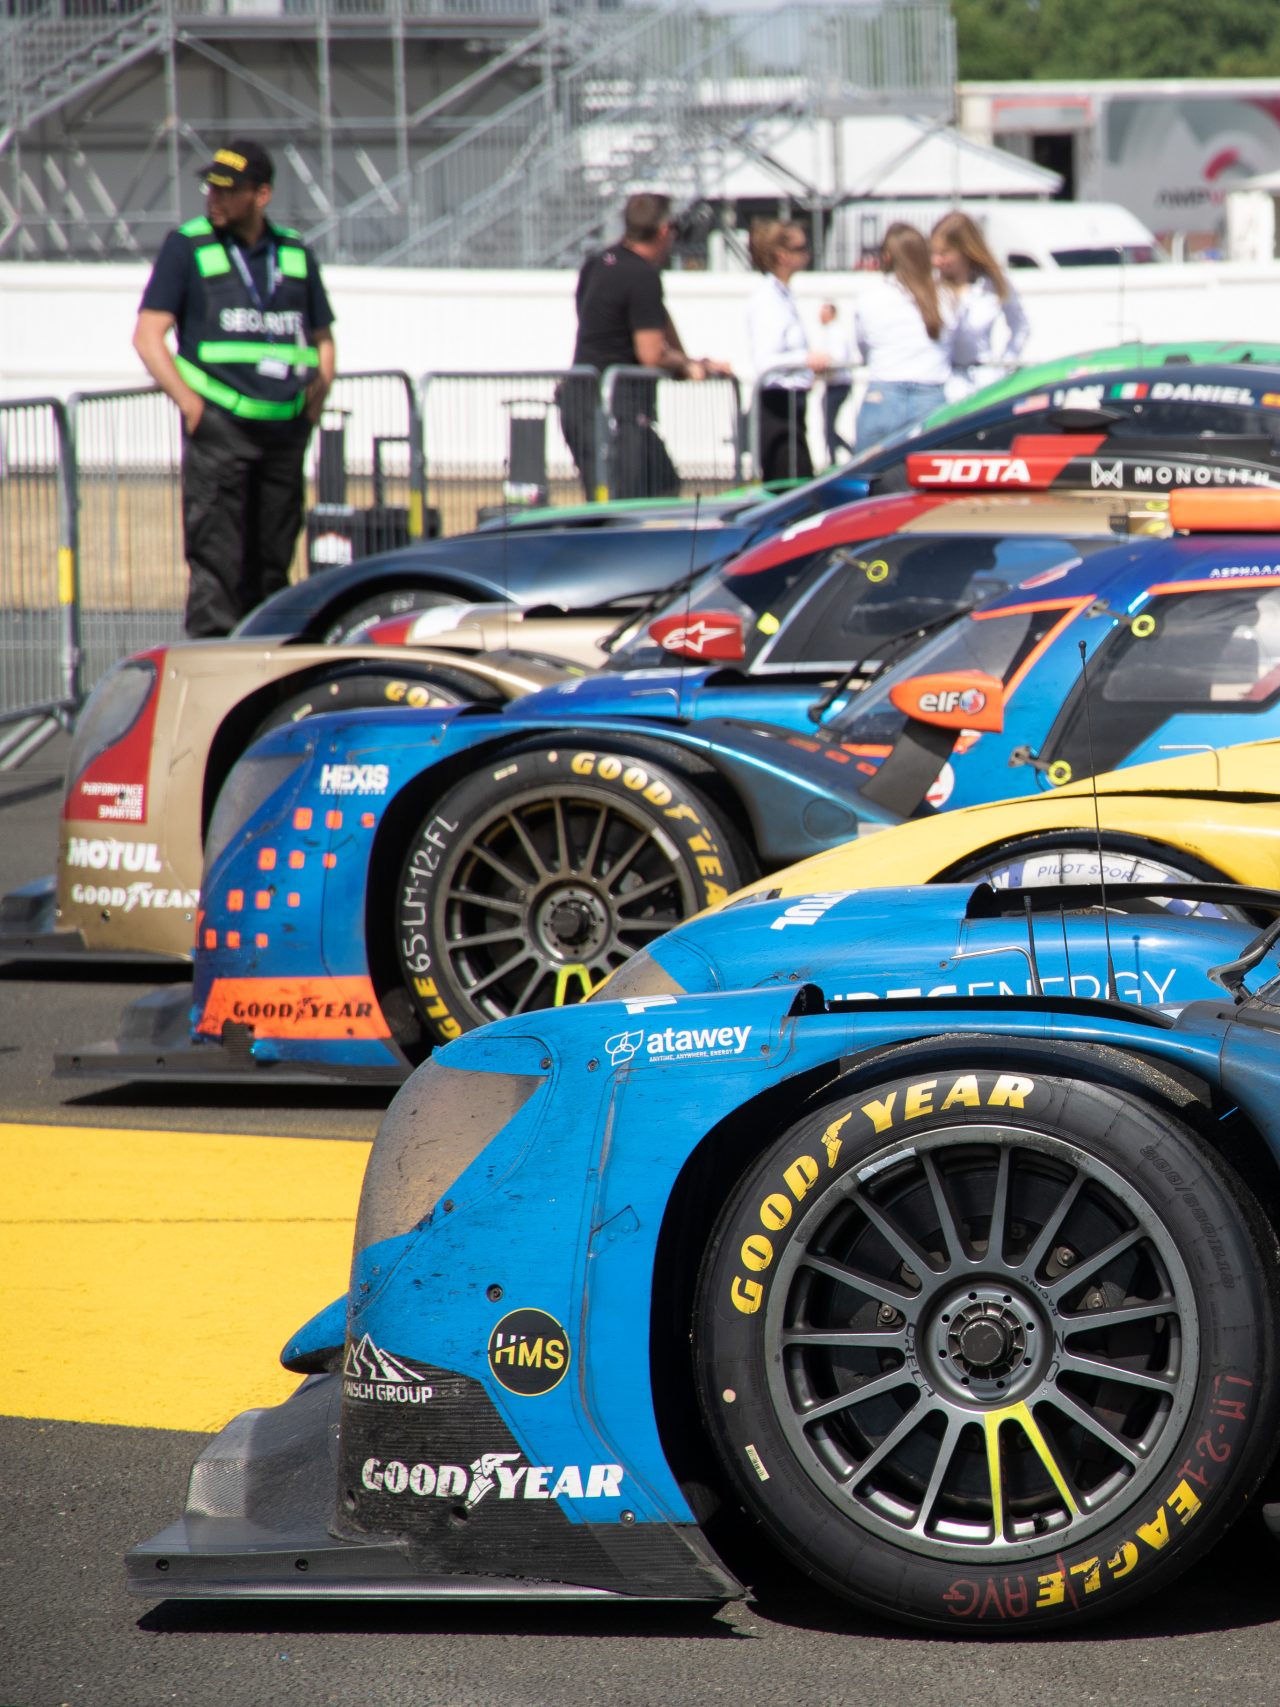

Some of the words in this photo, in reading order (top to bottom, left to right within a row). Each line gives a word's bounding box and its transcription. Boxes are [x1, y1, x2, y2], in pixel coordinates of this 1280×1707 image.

[1150, 383, 1255, 405] DANIEL
[918, 459, 1031, 482] JOTA
[1134, 466, 1270, 485] MONOLITH
[918, 690, 960, 712] elf
[320, 764, 389, 789] HEXIS
[98, 805, 143, 820] SMARTER
[571, 752, 729, 907] GOODYEA
[67, 837, 162, 873] MOTUL
[1037, 863, 1085, 878] PILOT
[1089, 863, 1145, 884] SPORT
[233, 998, 373, 1022] GOODYEAR
[414, 976, 463, 1039] GLE
[647, 1025, 752, 1054] atawey
[731, 1074, 1035, 1315] GOODYEAR
[376, 1384, 433, 1404] GROUP
[361, 1453, 624, 1509] GOODYEAR
[1036, 1479, 1202, 1608] EAGLE
